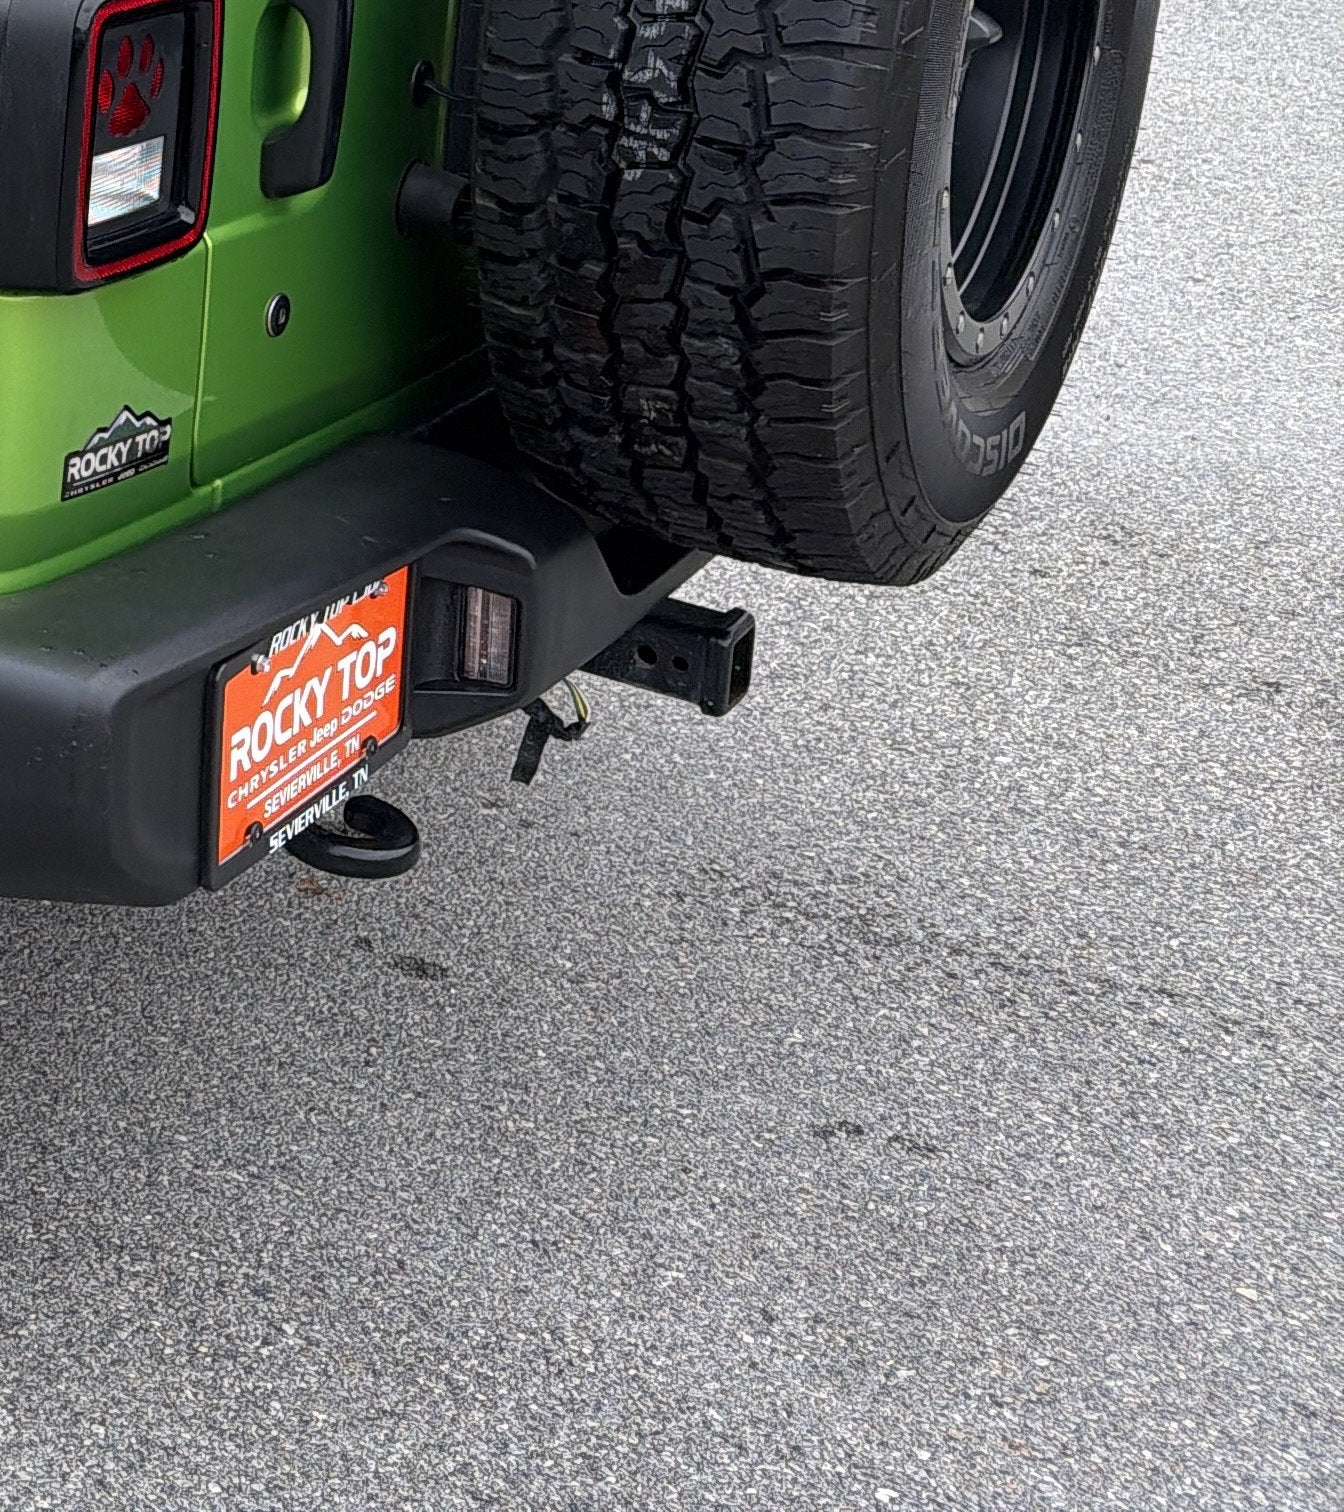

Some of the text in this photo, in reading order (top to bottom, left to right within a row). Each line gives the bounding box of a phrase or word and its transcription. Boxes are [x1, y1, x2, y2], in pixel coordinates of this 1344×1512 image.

[67, 424, 172, 483] ROCKY TOP
[227, 674, 396, 809] CHRYSLER Jeep DODGE
[229, 626, 397, 783] ROCKY TOP
[263, 733, 361, 818] SEVIERVILLE, TN
[269, 763, 370, 854] SEVIERVILLE, TN
